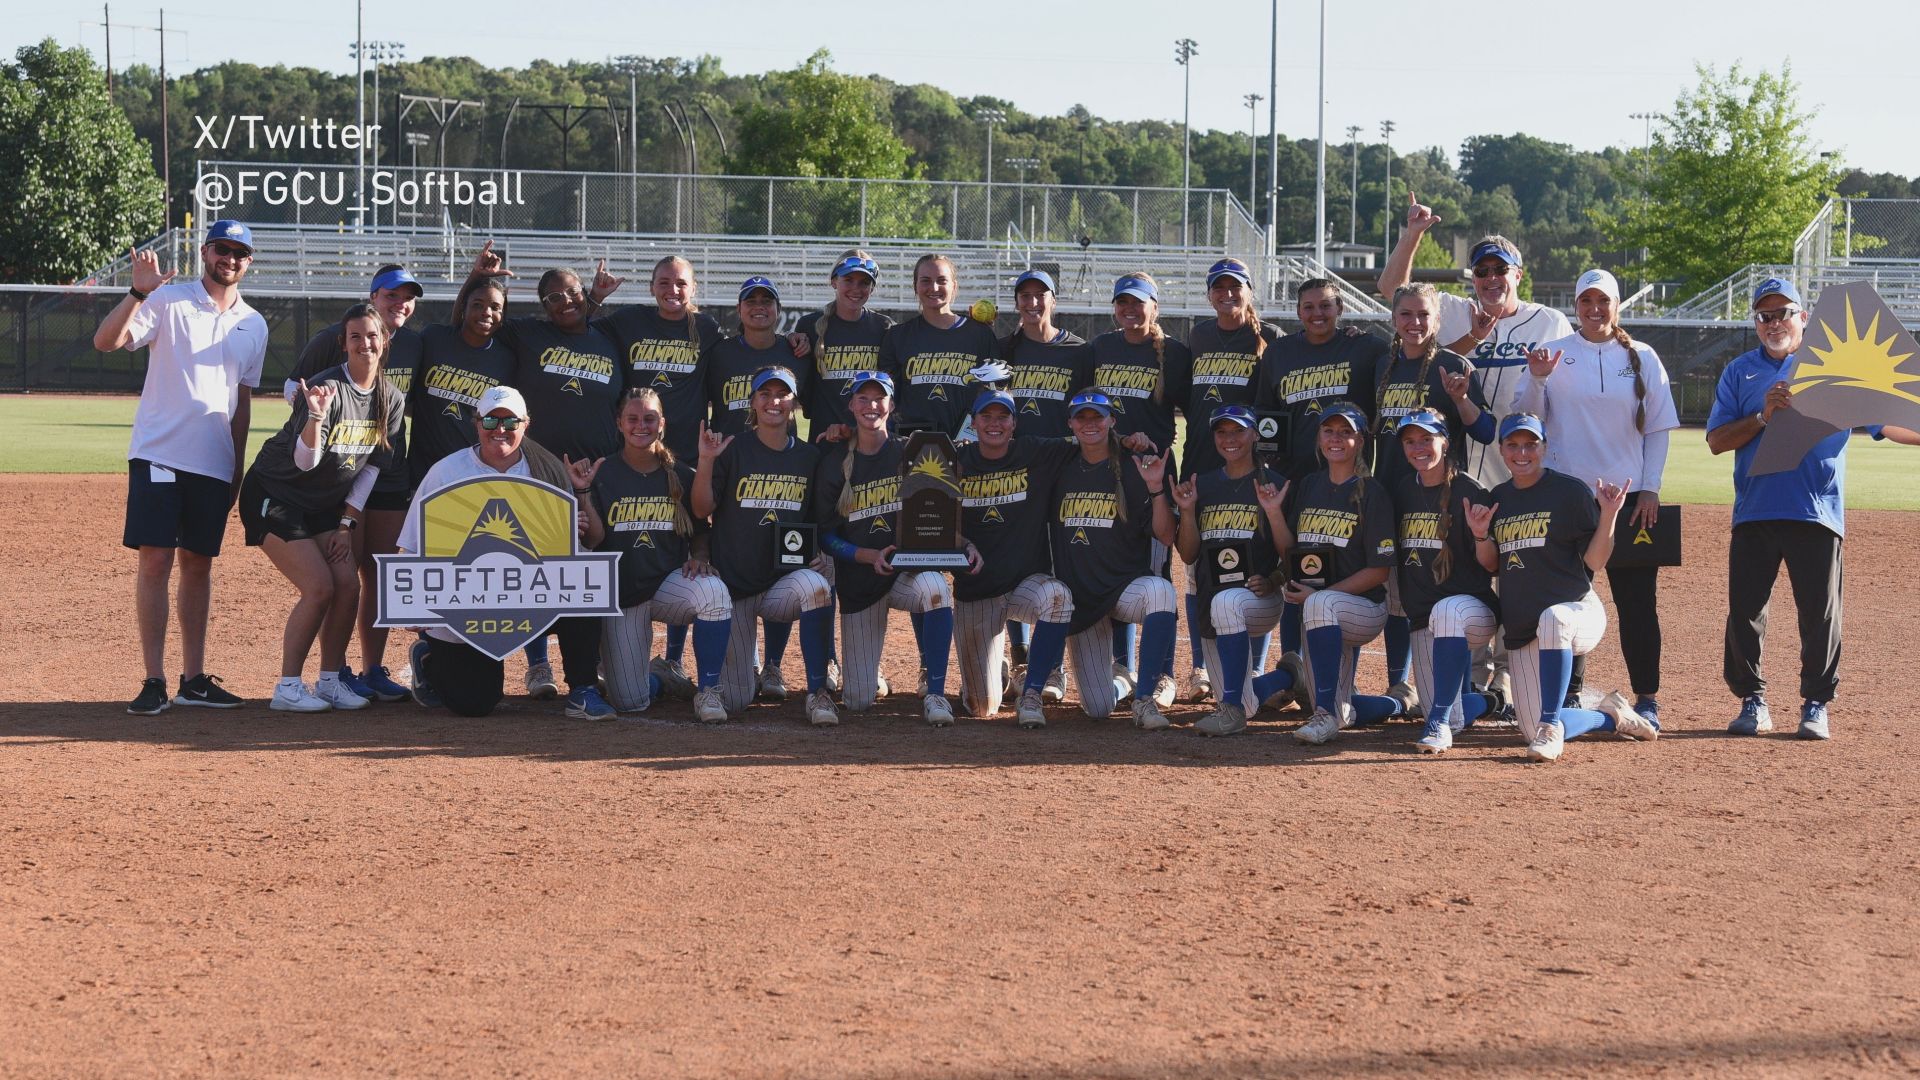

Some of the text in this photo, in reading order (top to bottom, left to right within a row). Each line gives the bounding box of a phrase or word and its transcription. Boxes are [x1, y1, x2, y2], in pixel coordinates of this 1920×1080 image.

[629, 341, 701, 365] CHAMPIONS
[1213, 352, 1243, 360] ATLANTIC
[540, 347, 614, 377] CHAMPIONS
[644, 363, 686, 372] SOFTBALL
[1117, 364, 1147, 372] ATLANTIC
[1193, 356, 1257, 378] CHAMPIONS
[438, 363, 456, 374] 2024
[456, 368, 488, 383] ATLANTIC
[556, 366, 601, 381] SOFTBALL
[1028, 365, 1059, 373] ATLANTIC
[1304, 363, 1335, 374] ATLANTIC
[921, 375, 961, 384] SOFTBALL
[1280, 367, 1352, 400] CHAMPIONS
[437, 389, 480, 408] SOFTBALL
[1016, 388, 1055, 399] SOFTBALL
[1294, 387, 1336, 401] SOFTBALL
[765, 474, 797, 482] ATLANTIC
[867, 477, 897, 490] ATLANTIC
[736, 477, 807, 502] CHAMPIONS
[636, 496, 668, 504] ATLANTIC
[972, 495, 1016, 507] SOFTBALL
[1077, 492, 1106, 500] ATLANTIC
[753, 499, 793, 510] SOFTBALL
[1315, 508, 1343, 518] ATLANTIC
[1507, 513, 1535, 523] ATLANTIC
[1535, 511, 1552, 519] SUN
[626, 521, 667, 531] SOFTBALL
[394, 566, 602, 593] SOFTBALL
[402, 593, 594, 605] CHAMPIONS
[465, 620, 532, 634] 2024
